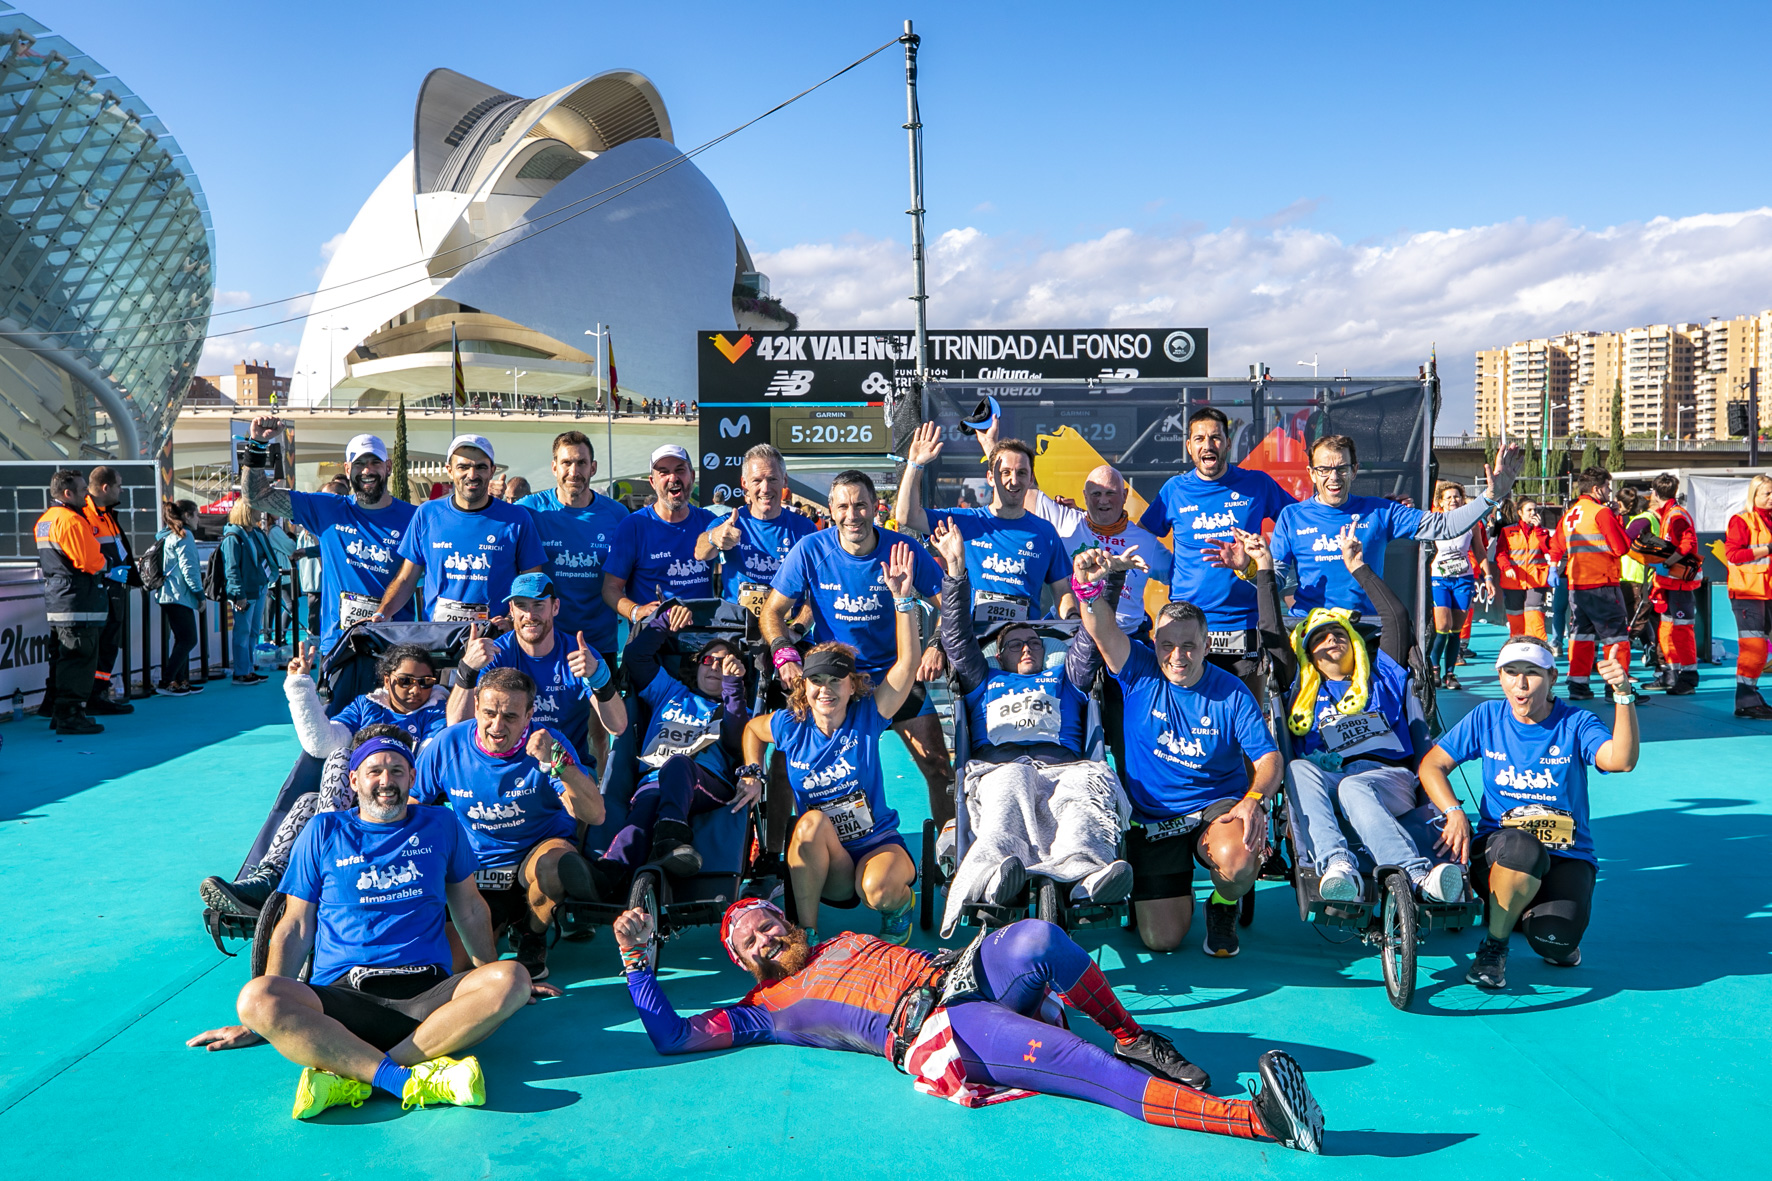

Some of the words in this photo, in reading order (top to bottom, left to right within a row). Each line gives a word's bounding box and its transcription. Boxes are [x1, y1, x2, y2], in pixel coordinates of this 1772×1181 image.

[757, 336, 807, 360] 42K
[928, 335, 1037, 360] TRINIDAD
[1039, 334, 1152, 360] ALFONSO
[978, 367, 1030, 380] Cultura
[791, 425, 873, 443] 5:20:26
[650, 551, 672, 560] aefat
[1018, 549, 1040, 558] ZURICH
[555, 570, 598, 578] #Imparables
[670, 576, 710, 586] #Imparables
[835, 613, 880, 622] #Imparables
[988, 606, 1016, 618] 28216
[1000, 696, 1052, 718] aefat
[1014, 718, 1036, 730] JON
[1336, 718, 1368, 733] 25803
[1343, 725, 1371, 742] ALEX
[834, 738, 858, 756] ZURICH
[506, 787, 536, 798] ZURICH
[808, 780, 858, 799] #Imparables
[472, 818, 526, 831] #Imparables
[402, 848, 432, 857] ZURICH
[336, 855, 365, 867] aefat
[360, 888, 423, 904] #Imparables
